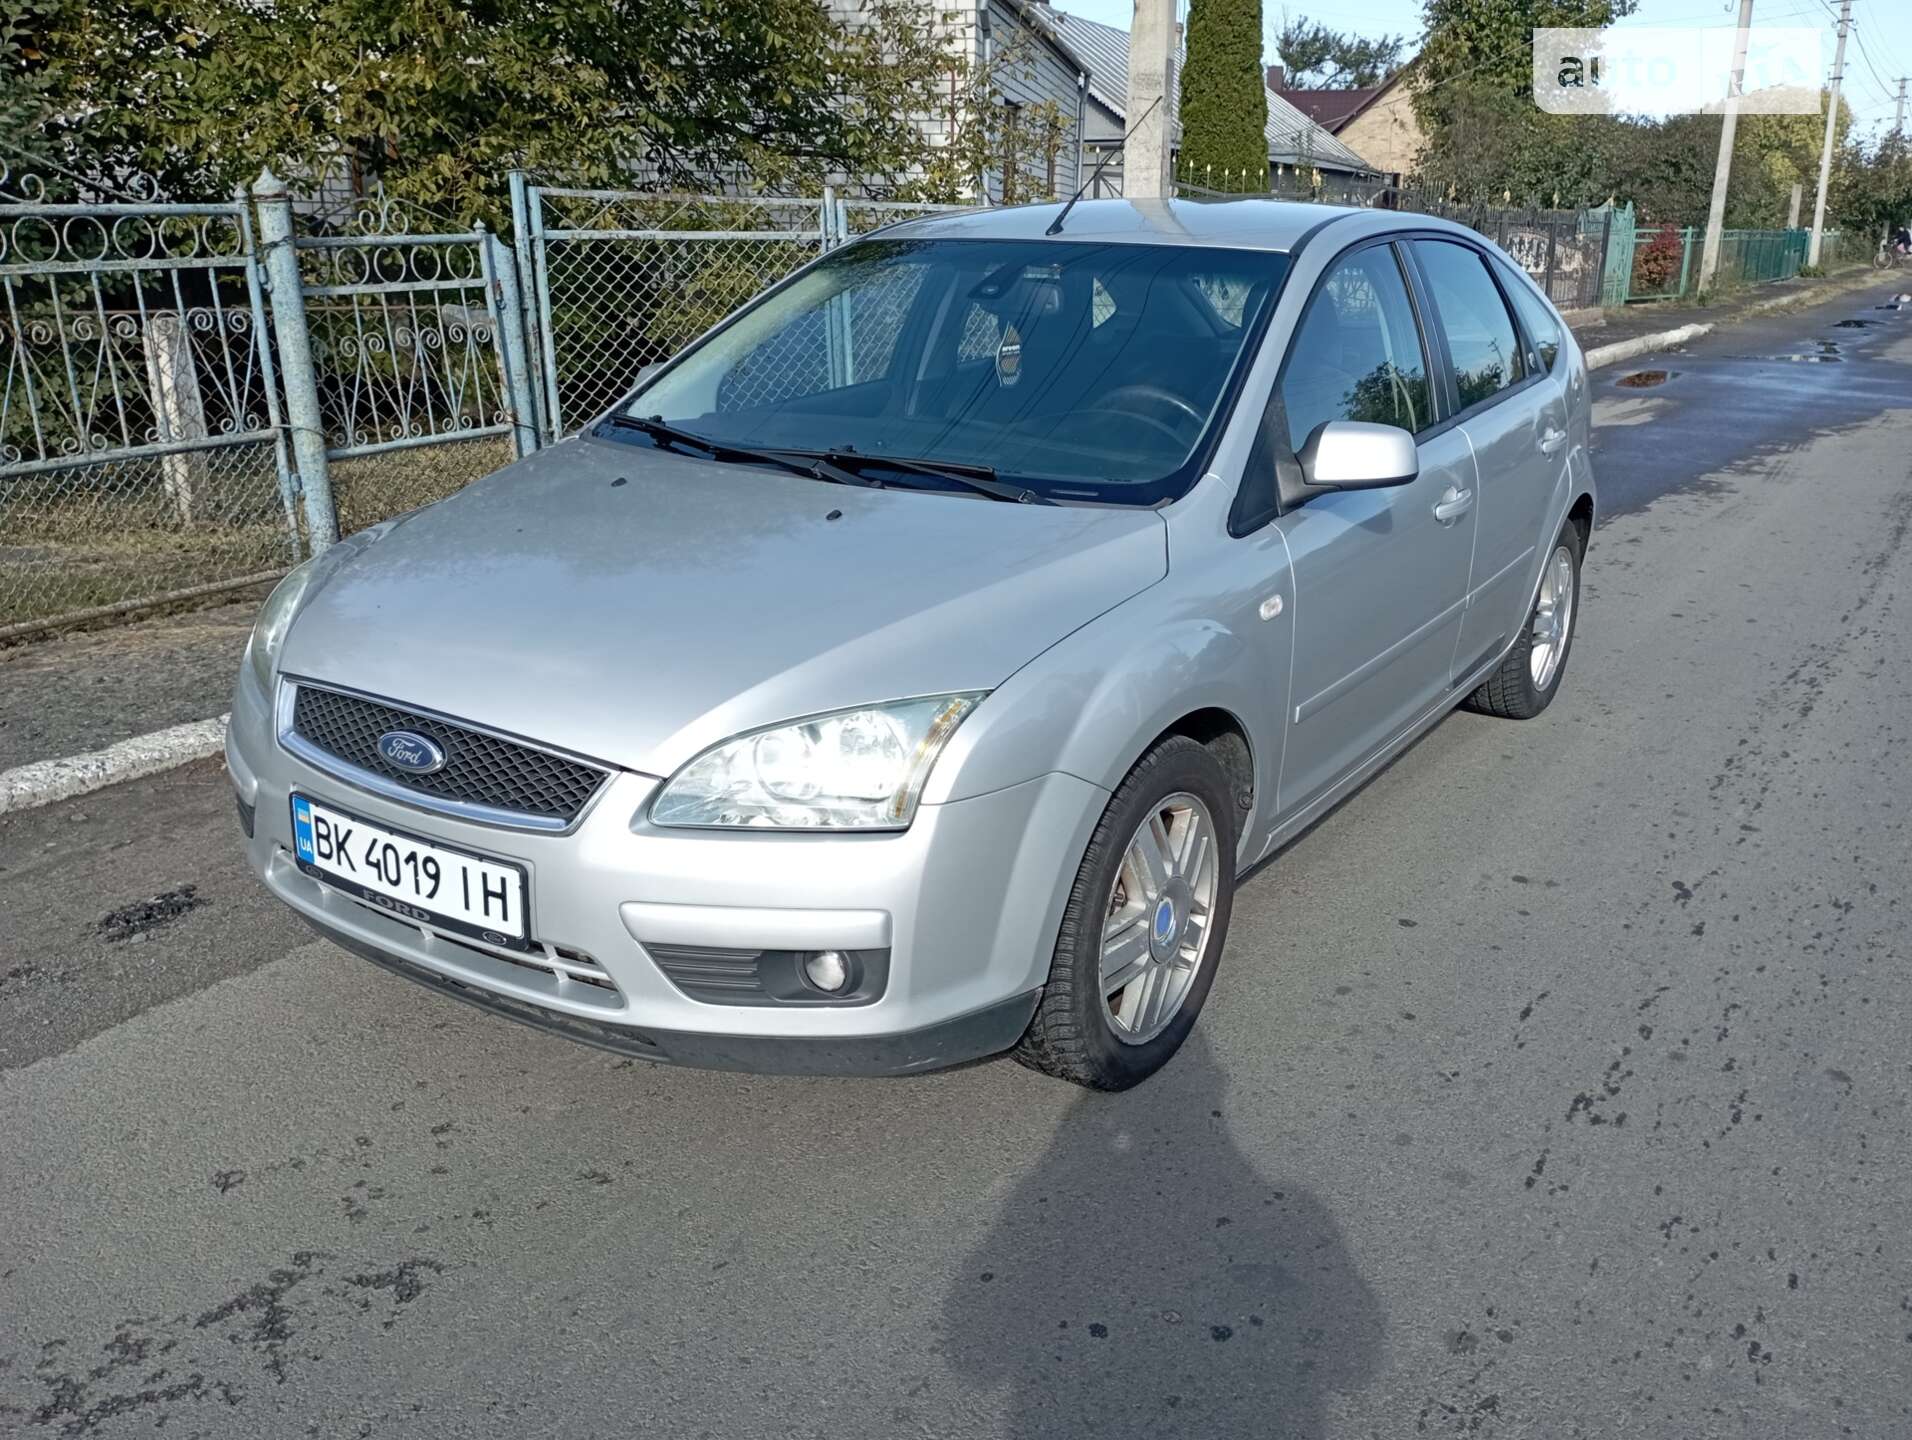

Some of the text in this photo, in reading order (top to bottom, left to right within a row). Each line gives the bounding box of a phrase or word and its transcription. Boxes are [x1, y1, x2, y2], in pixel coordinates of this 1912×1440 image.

[387, 737, 423, 765] Ford
[300, 836, 313, 854] UA
[314, 815, 509, 923] BK 4019 IH
[363, 888, 431, 922] FORD
